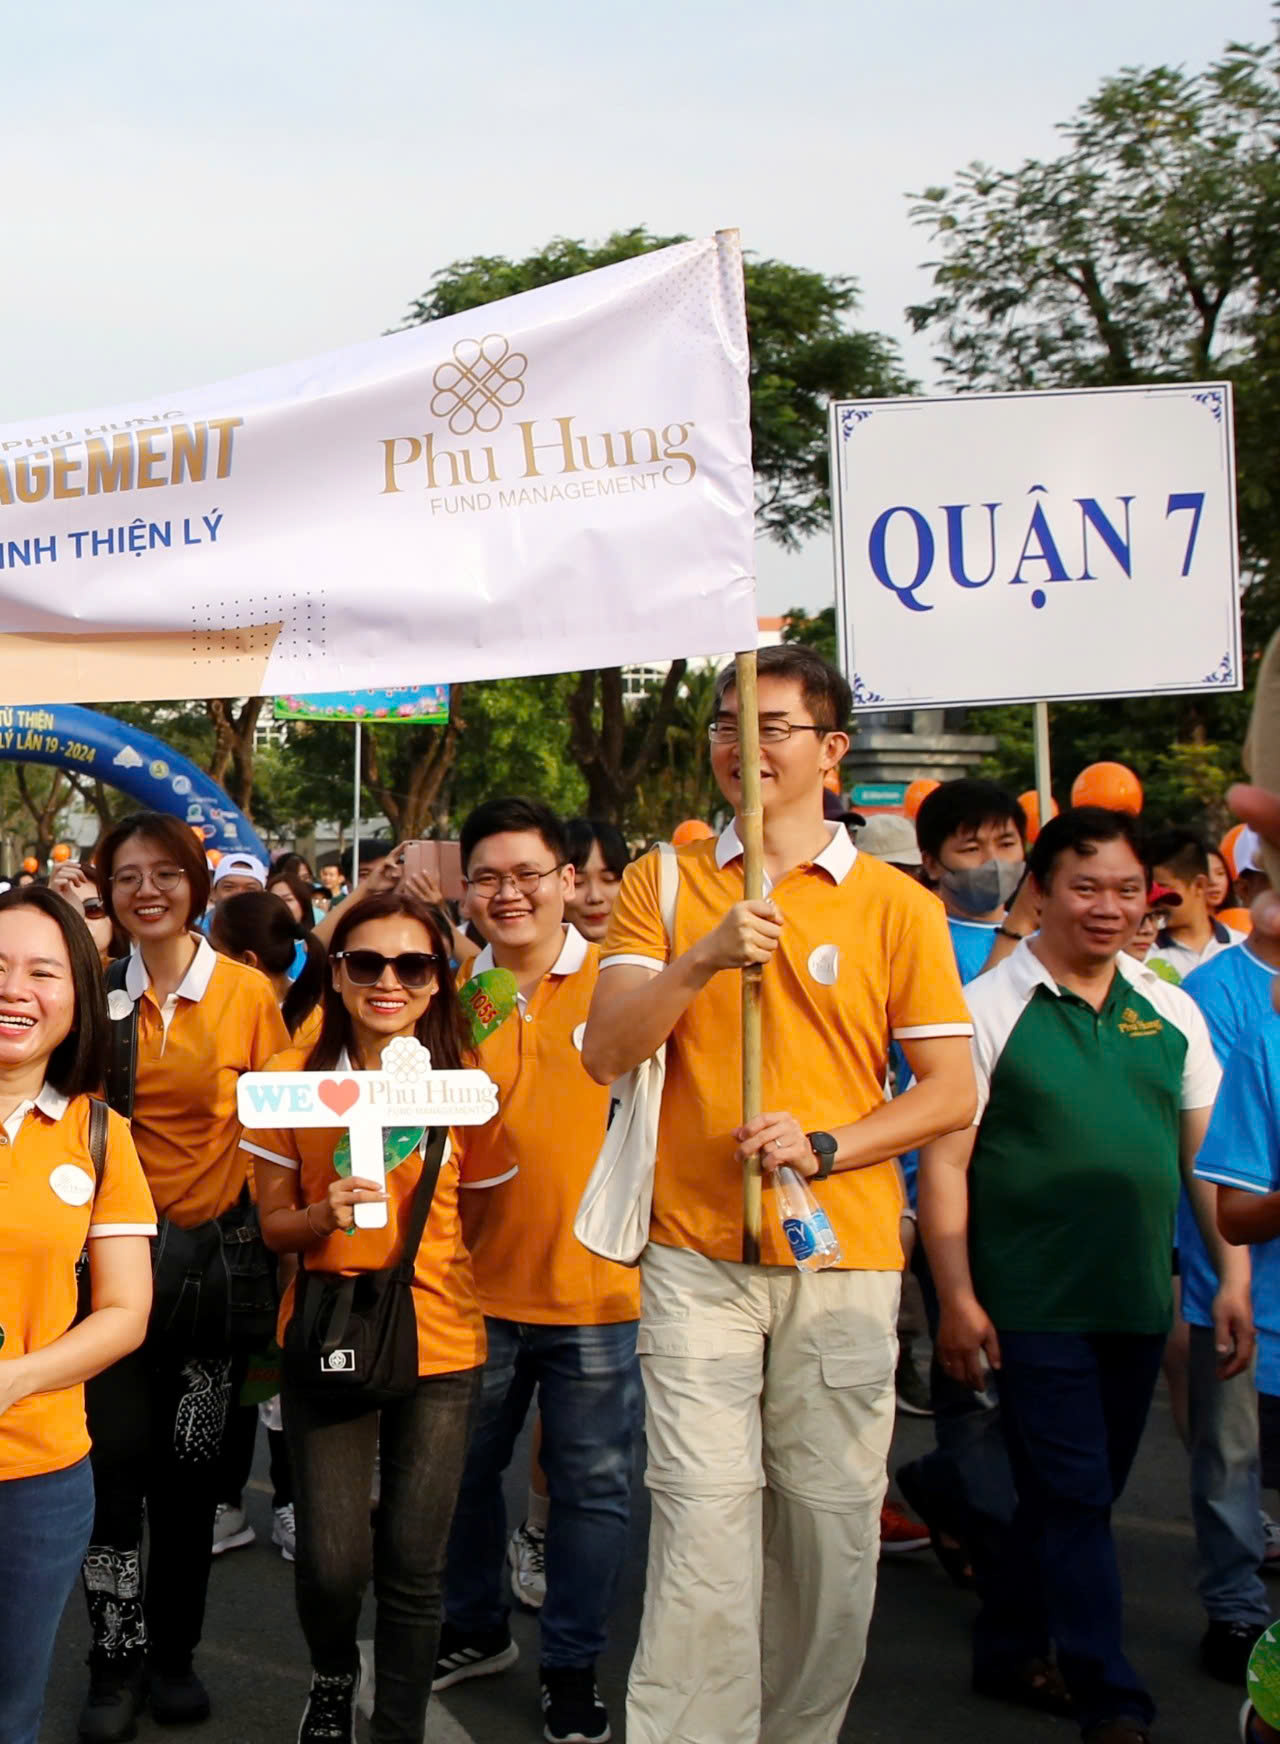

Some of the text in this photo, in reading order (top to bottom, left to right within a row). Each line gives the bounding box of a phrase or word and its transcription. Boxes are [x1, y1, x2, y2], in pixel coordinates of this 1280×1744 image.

[379, 415, 697, 495] Phu Hung
[430, 472, 661, 516] FUND MANAGEMENT
[68, 517, 171, 559] THIỆN
[183, 507, 224, 545] LÝ
[868, 484, 1206, 612] QUẬN 7
[17, 709, 55, 731] THIỆN
[45, 736, 59, 754] 19
[65, 741, 97, 764] 2024
[245, 1080, 496, 1114] WE Phu Hung
